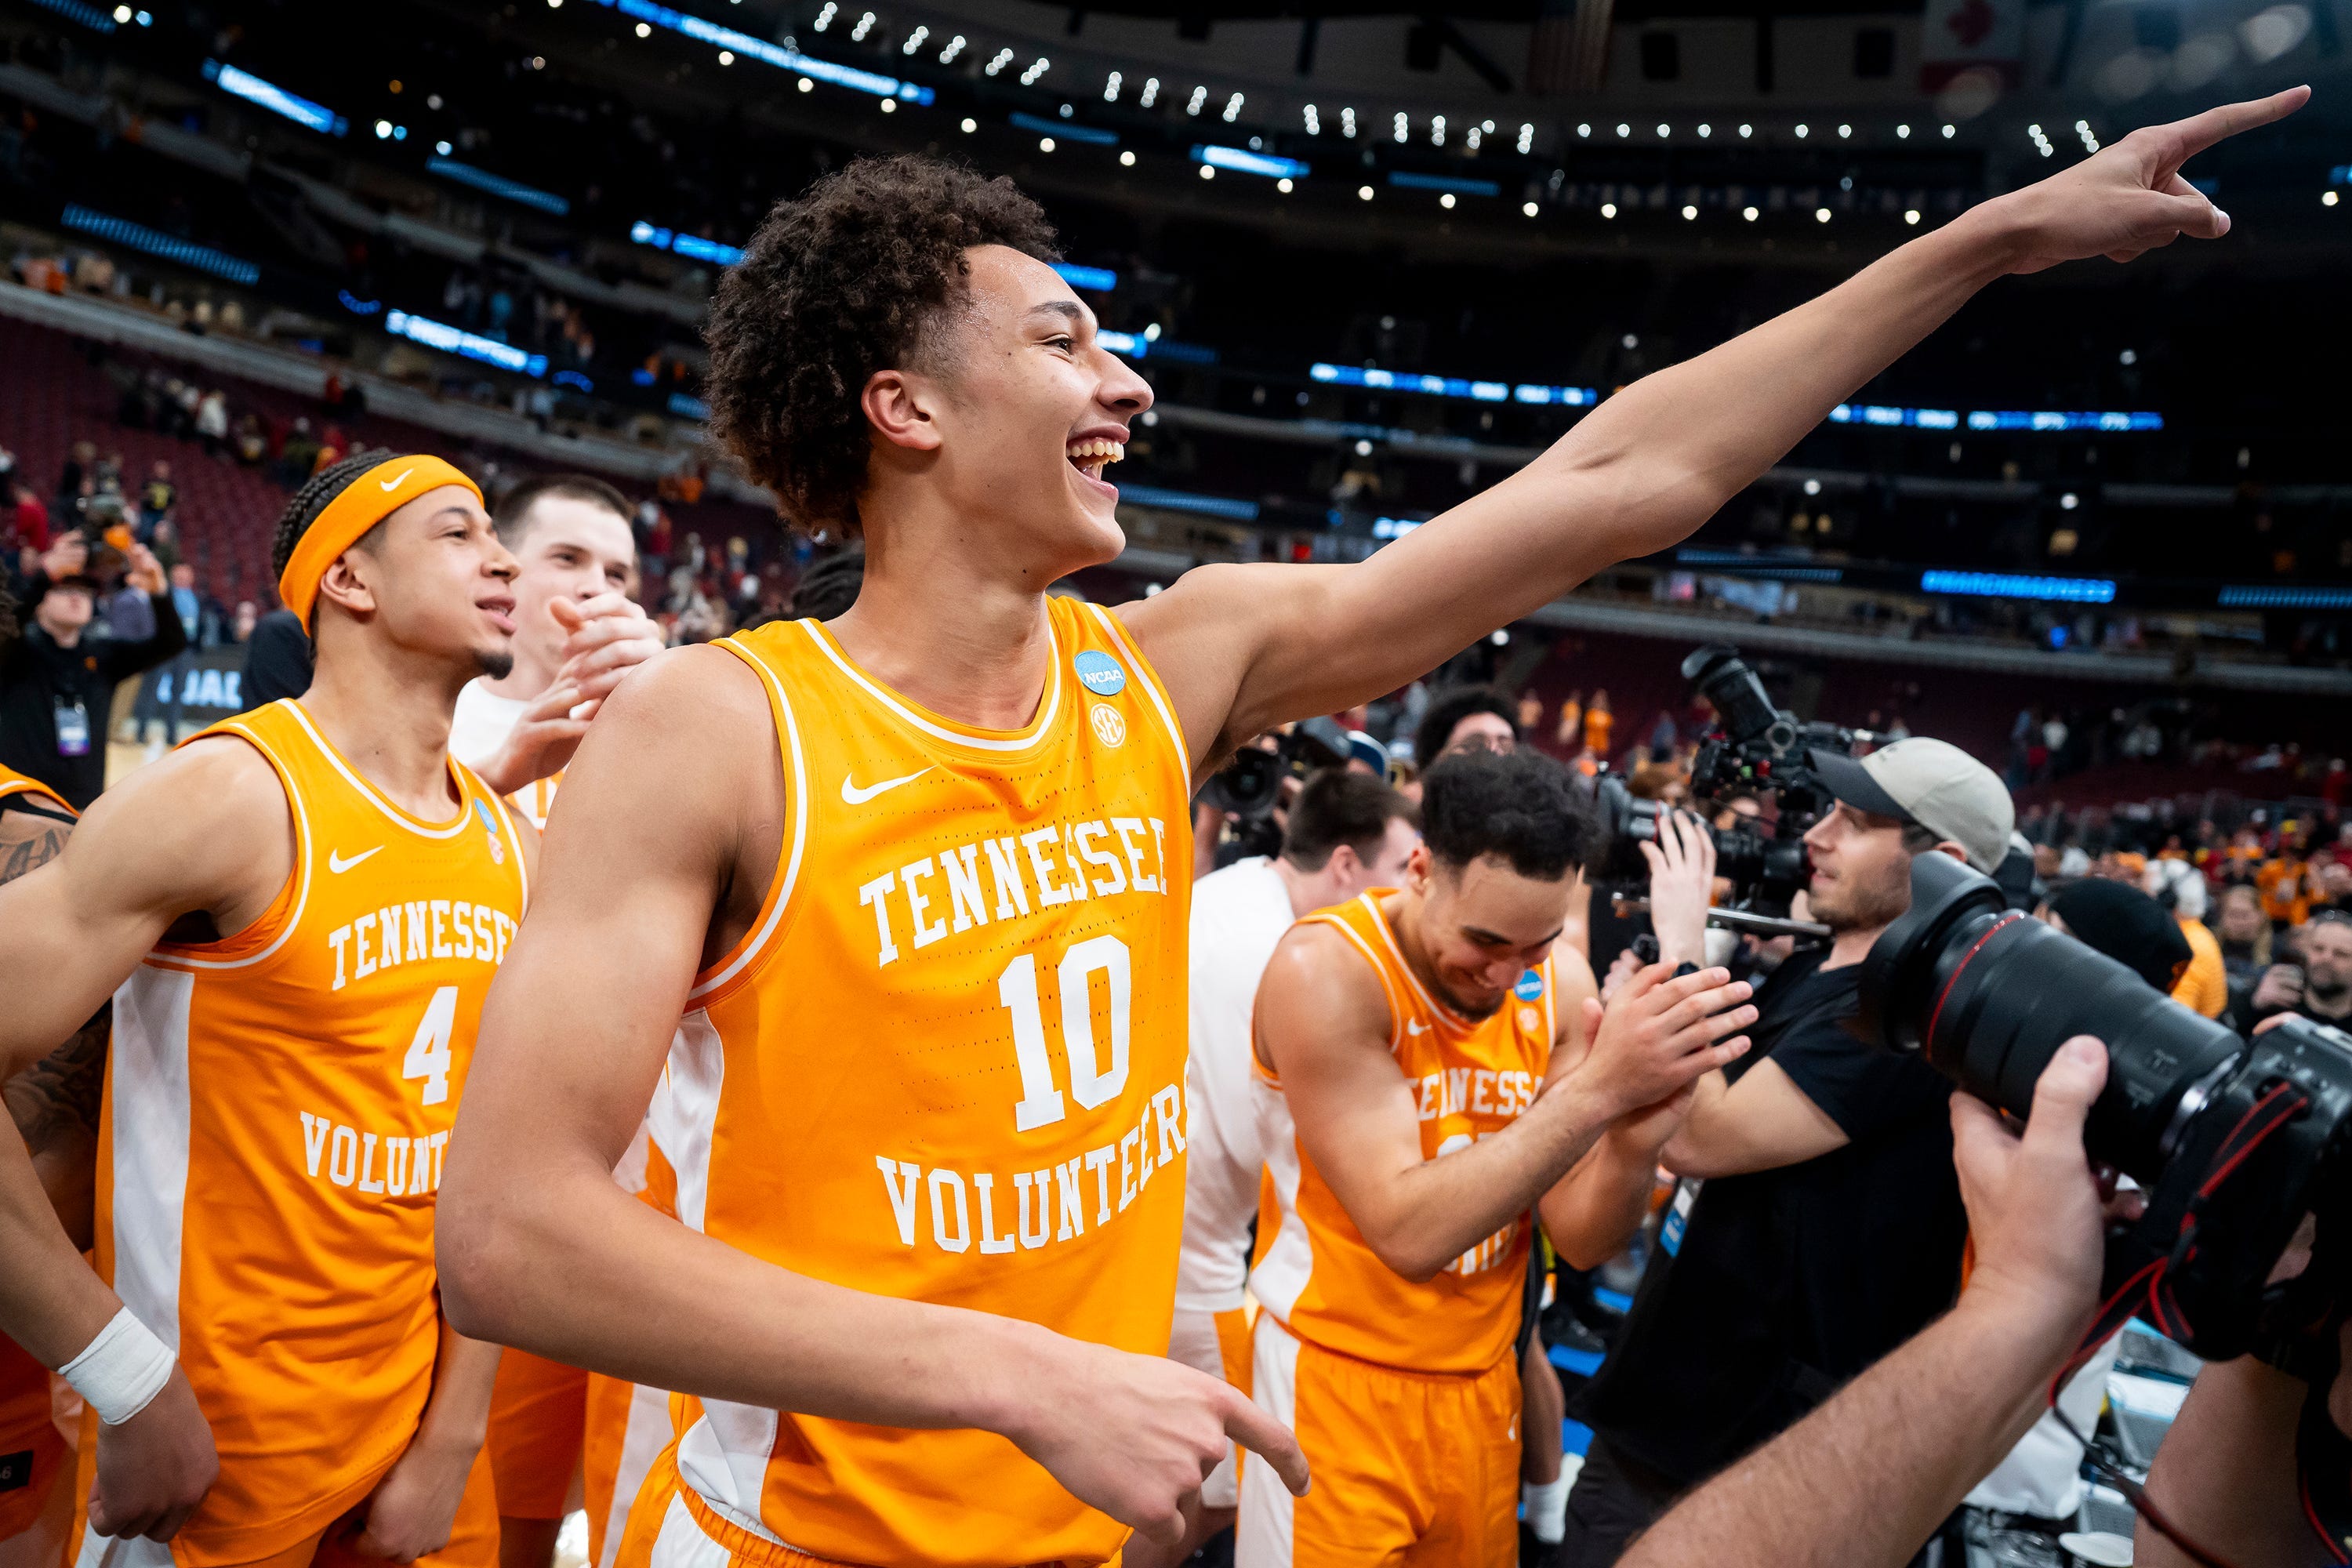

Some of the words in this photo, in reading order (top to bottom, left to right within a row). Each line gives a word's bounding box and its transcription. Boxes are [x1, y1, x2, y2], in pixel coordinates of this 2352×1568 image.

[1083, 669, 1124, 684] NCAA
[1093, 707, 1123, 744] SEC
[328, 900, 519, 990] TENNESSE
[402, 986, 459, 1106] 4
[997, 935, 1132, 1132] 10
[300, 1110, 455, 1196] VOLUNT
[876, 1054, 1189, 1254] VOLUNTEER
